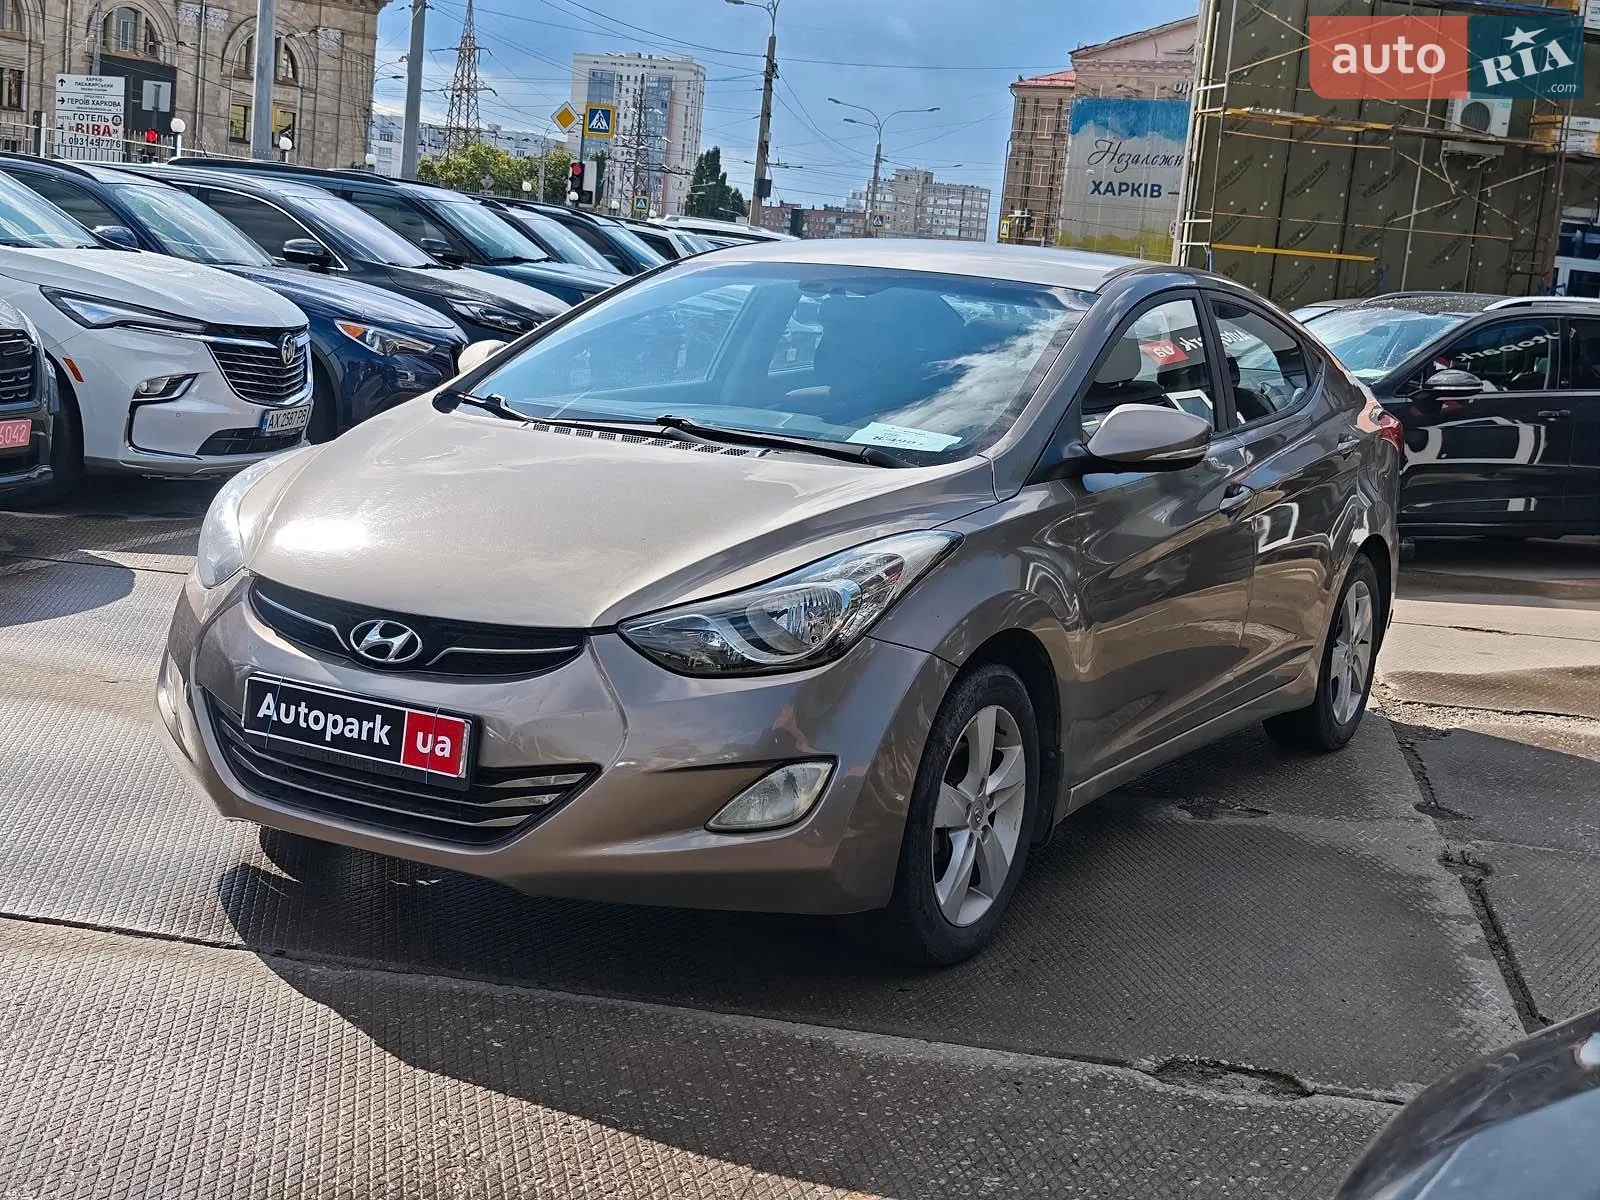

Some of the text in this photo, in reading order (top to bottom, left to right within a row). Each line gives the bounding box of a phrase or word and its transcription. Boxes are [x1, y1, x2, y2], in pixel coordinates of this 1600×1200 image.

[67, 97, 122, 108] ГЕРОЇВ ХАРКОВА
[73, 113, 110, 123] ГОТЕЛЬ
[1090, 180, 1162, 198] ХАРКІВ
[257, 692, 451, 758] Autopark ua
